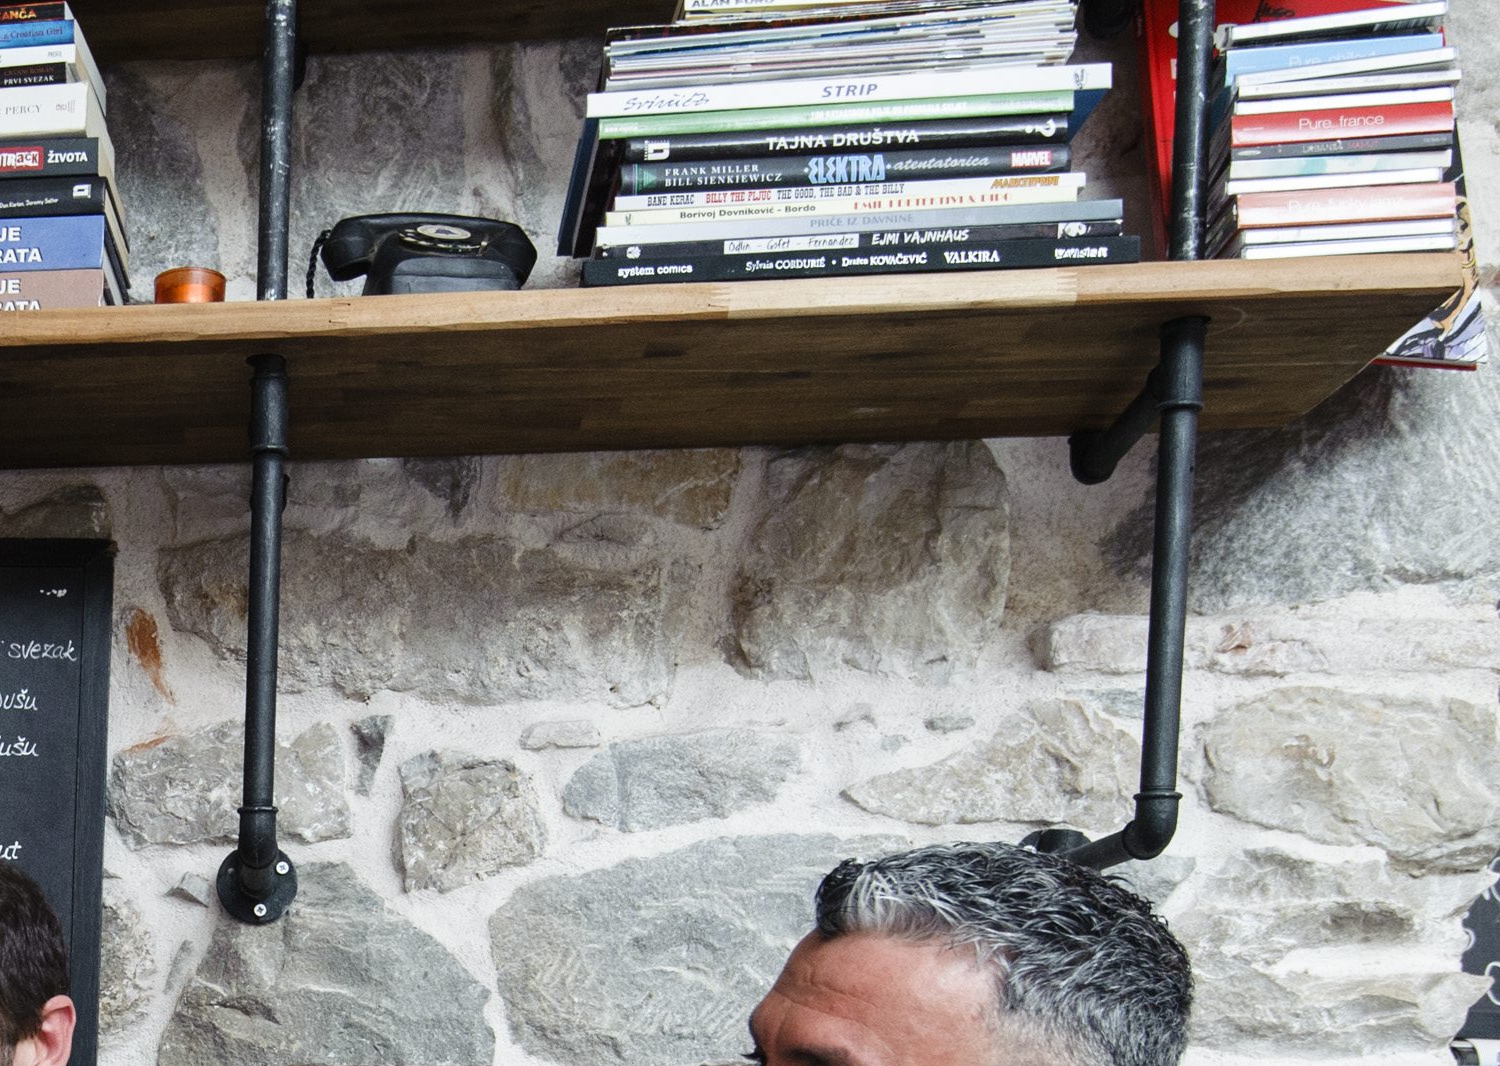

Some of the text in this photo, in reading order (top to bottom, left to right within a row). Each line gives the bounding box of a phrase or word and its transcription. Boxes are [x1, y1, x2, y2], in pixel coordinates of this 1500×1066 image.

[4, 75, 55, 86] PRVI SVEZAK
[822, 83, 879, 99] STRIP
[5, 103, 42, 116] PERCY
[1299, 113, 1384, 131] Pure france
[766, 127, 920, 151] TAJNA DRUŠTVA
[48, 150, 88, 163] ŽIVOTA
[1012, 151, 1050, 168] MARVEL
[665, 164, 760, 178] FRANK MILLER
[808, 154, 990, 184] ELEKTRA atentatorica
[665, 172, 783, 187] BILL SIENKIEWICZ
[706, 192, 728, 204] BILLY
[730, 191, 746, 203] THE
[777, 188, 793, 200] THE
[820, 187, 836, 198] THE
[838, 186, 853, 197] BAD
[864, 184, 880, 196] THE
[882, 183, 905, 194] BILLY
[647, 196, 668, 208] BANE
[680, 203, 817, 220] Borivoj Dovniković Bordo
[810, 213, 914, 229] PRIČE IZ DAVNINE
[808, 236, 855, 248] Fernandez
[871, 229, 970, 246] EJMI VAJNHAUS
[869, 252, 928, 266] KOVAČEVIĆ
[944, 251, 1000, 264] VALKIRA
[618, 263, 693, 279] system comics
[8, 638, 78, 662] svezak
